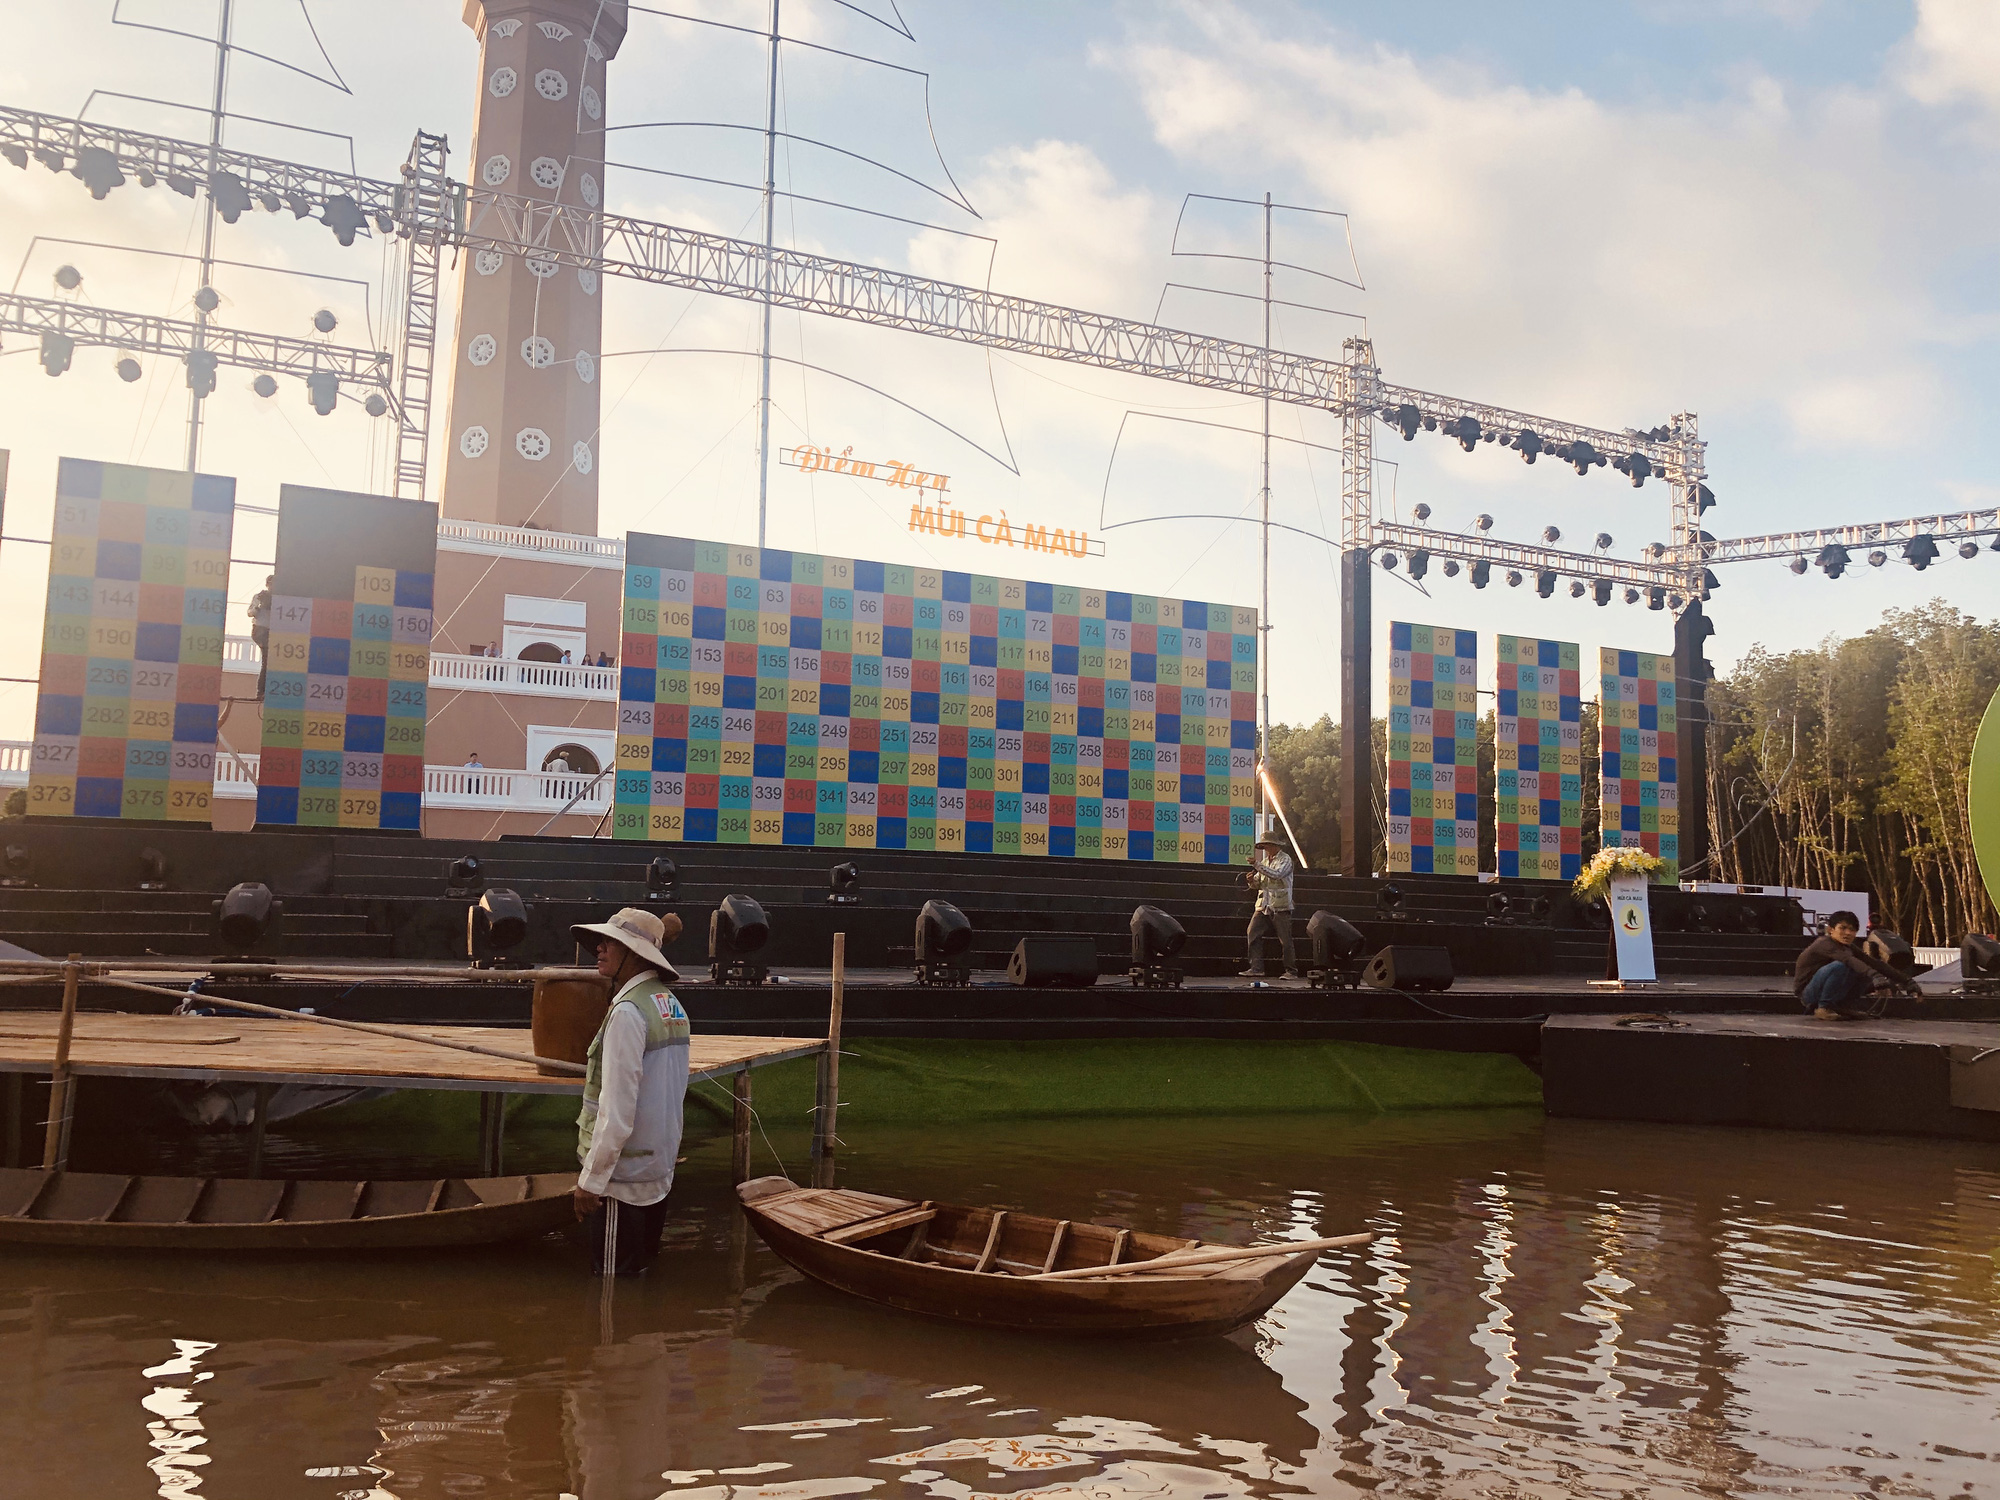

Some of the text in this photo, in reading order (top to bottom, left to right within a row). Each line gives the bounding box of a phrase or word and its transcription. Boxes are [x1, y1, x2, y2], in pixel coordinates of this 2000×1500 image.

[909, 500, 1088, 559] MŨI CÀ MAU
[362, 577, 391, 592] 103
[635, 575, 652, 588] 59
[667, 578, 685, 592] 60
[98, 590, 135, 606] 144
[734, 585, 752, 599] 62
[766, 589, 784, 602] 63
[189, 598, 223, 614] 146
[829, 597, 847, 609] 65
[859, 600, 876, 612] 66
[275, 606, 308, 621] 147
[919, 607, 935, 619] 68
[948, 610, 964, 622] 69
[357, 613, 389, 629] 149
[397, 617, 428, 632] 150
[1004, 616, 1017, 628] 71
[1031, 619, 1046, 631] 72
[95, 629, 132, 645] 190
[1085, 625, 1099, 637] 74
[1111, 628, 1125, 640] 75
[186, 637, 220, 652] 192
[1162, 634, 1176, 645] 77
[1187, 636, 1201, 648] 78
[1416, 633, 1428, 644] 36
[1438, 635, 1450, 646] 37
[273, 643, 306, 659] 193
[1236, 642, 1250, 654] 80
[1521, 645, 1533, 656] 40
[355, 650, 387, 666] 195
[394, 653, 426, 669] 196
[1393, 657, 1405, 668] 81
[1438, 662, 1450, 673] 83
[90, 667, 129, 686] 236
[136, 671, 174, 687] 237
[269, 681, 303, 696] 239
[310, 684, 344, 699] 240
[391, 690, 423, 705] 242
[86, 707, 126, 725] 282
[132, 711, 171, 727] 283
[623, 710, 651, 724] 243
[691, 715, 719, 729] 245
[1391, 712, 1409, 724] 173
[1413, 714, 1430, 725] 174
[265, 719, 301, 735] 285
[307, 722, 341, 737] 286
[725, 717, 752, 731] 246
[789, 722, 816, 735] 248
[1457, 718, 1474, 730] 176
[1499, 722, 1516, 733] 177
[388, 727, 422, 742] 288
[821, 724, 847, 738] 249
[882, 728, 905, 742] 251
[1541, 726, 1558, 737] 179
[1562, 728, 1578, 739] 180
[912, 731, 936, 744] 252
[970, 736, 993, 748] 254
[1622, 734, 1637, 745] 182
[1641, 736, 1656, 747] 183
[997, 738, 1021, 750] 255
[1052, 742, 1075, 754] 257
[1389, 739, 1409, 751] 219
[1412, 741, 1431, 753] 220
[35, 745, 75, 761] 327
[1079, 744, 1101, 757] 258
[1131, 748, 1153, 761] 260
[1157, 751, 1176, 762] 261
[1456, 745, 1474, 757] 222
[1498, 749, 1516, 760] 223
[130, 750, 168, 766] 329
[175, 752, 212, 768] 330
[1207, 754, 1228, 766] 263
[1232, 756, 1252, 768] 264
[1540, 752, 1558, 764] 225
[1561, 754, 1578, 765] 226
[304, 760, 338, 775] 332
[346, 762, 379, 777] 333
[1622, 760, 1637, 771] 228
[1641, 762, 1657, 772] 229
[1412, 769, 1431, 781] 266
[1435, 771, 1453, 782] 267
[618, 779, 648, 793] 335
[654, 781, 682, 794] 336
[1498, 776, 1516, 787] 269
[1519, 778, 1537, 788] 270
[1561, 781, 1578, 791] 272
[32, 786, 72, 802] 373
[721, 784, 749, 798] 338
[754, 786, 782, 799] 339
[1602, 784, 1619, 795] 273
[1641, 787, 1657, 798] 275
[1660, 789, 1675, 799] 276
[125, 790, 164, 806] 375
[171, 792, 208, 808] 376
[819, 790, 842, 802] 341
[849, 791, 875, 804] 342
[910, 795, 934, 807] 344
[1412, 796, 1431, 808] 312
[302, 798, 336, 813] 378
[343, 800, 377, 815] 379
[939, 796, 964, 809] 345
[996, 800, 1019, 812] 347
[1024, 801, 1047, 814] 348
[1435, 798, 1453, 809] 313
[1498, 803, 1516, 814] 315
[1078, 805, 1100, 817] 350
[1104, 806, 1124, 818] 351
[1520, 804, 1537, 815] 316
[1562, 807, 1578, 818] 318
[1603, 810, 1619, 821] 319
[617, 814, 646, 828] 381
[652, 815, 681, 829] 382
[1156, 810, 1177, 822] 353
[1181, 811, 1202, 823] 354
[1232, 814, 1252, 826] 356
[1641, 813, 1656, 824] 321
[1660, 814, 1675, 826] 322
[720, 818, 747, 831] 384
[753, 819, 780, 833] 385
[817, 822, 843, 835] 387
[848, 824, 874, 836] 388
[1389, 823, 1409, 834] 357
[909, 826, 933, 839] 390
[937, 828, 960, 840] 391
[996, 831, 1019, 843] 393
[1435, 826, 1454, 837] 359
[1457, 827, 1475, 838] 360
[1520, 831, 1537, 842] 362
[1541, 832, 1558, 843] 363
[1023, 832, 1046, 845] 394
[1077, 835, 1099, 847] 396
[1104, 837, 1125, 849] 397
[1155, 839, 1177, 851] 399
[1181, 841, 1202, 852] 400
[1231, 843, 1251, 855] 402
[1660, 840, 1676, 851] 368
[1388, 851, 1409, 864] 403
[1435, 853, 1454, 865] 405
[1457, 855, 1475, 866] 406
[1520, 858, 1538, 869] 408
[1541, 859, 1558, 870] 409
